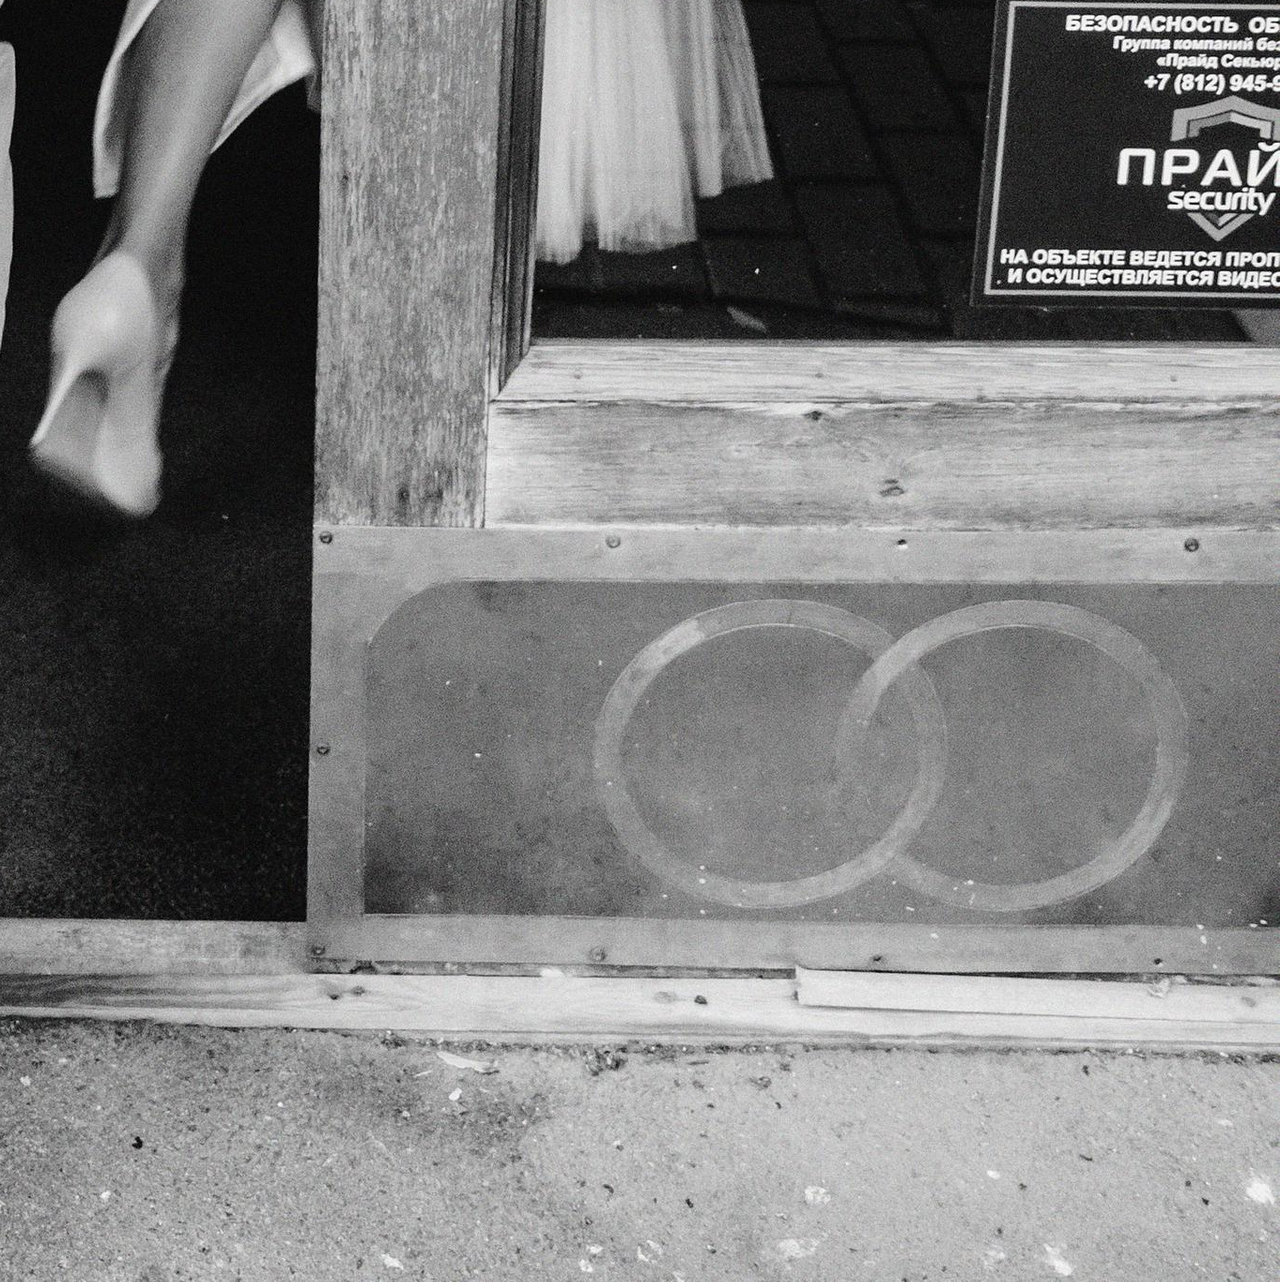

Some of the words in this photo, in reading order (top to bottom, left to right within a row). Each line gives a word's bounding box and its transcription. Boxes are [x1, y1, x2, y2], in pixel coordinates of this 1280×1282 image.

[1066, 15, 1239, 33] БЕЗОПАСНОСТЬ
[1113, 36, 1171, 52] Группа
[1173, 37, 1254, 50] компаний
[1157, 53, 1218, 70] «Прайд
[1144, 74, 1170, 90] +7
[1174, 74, 1225, 95] (812)
[1167, 186, 1276, 217] security
[1000, 249, 1028, 264] НА
[1031, 249, 1126, 265] ОБЪЕКТЕ
[1129, 251, 1222, 268] ВЕДЕТСЯ
[1226, 252, 1280, 267] ПРОП
[1008, 268, 1022, 283] И
[1026, 267, 1214, 286] ОСУЩЕСТВЛЯЕТСЯ
